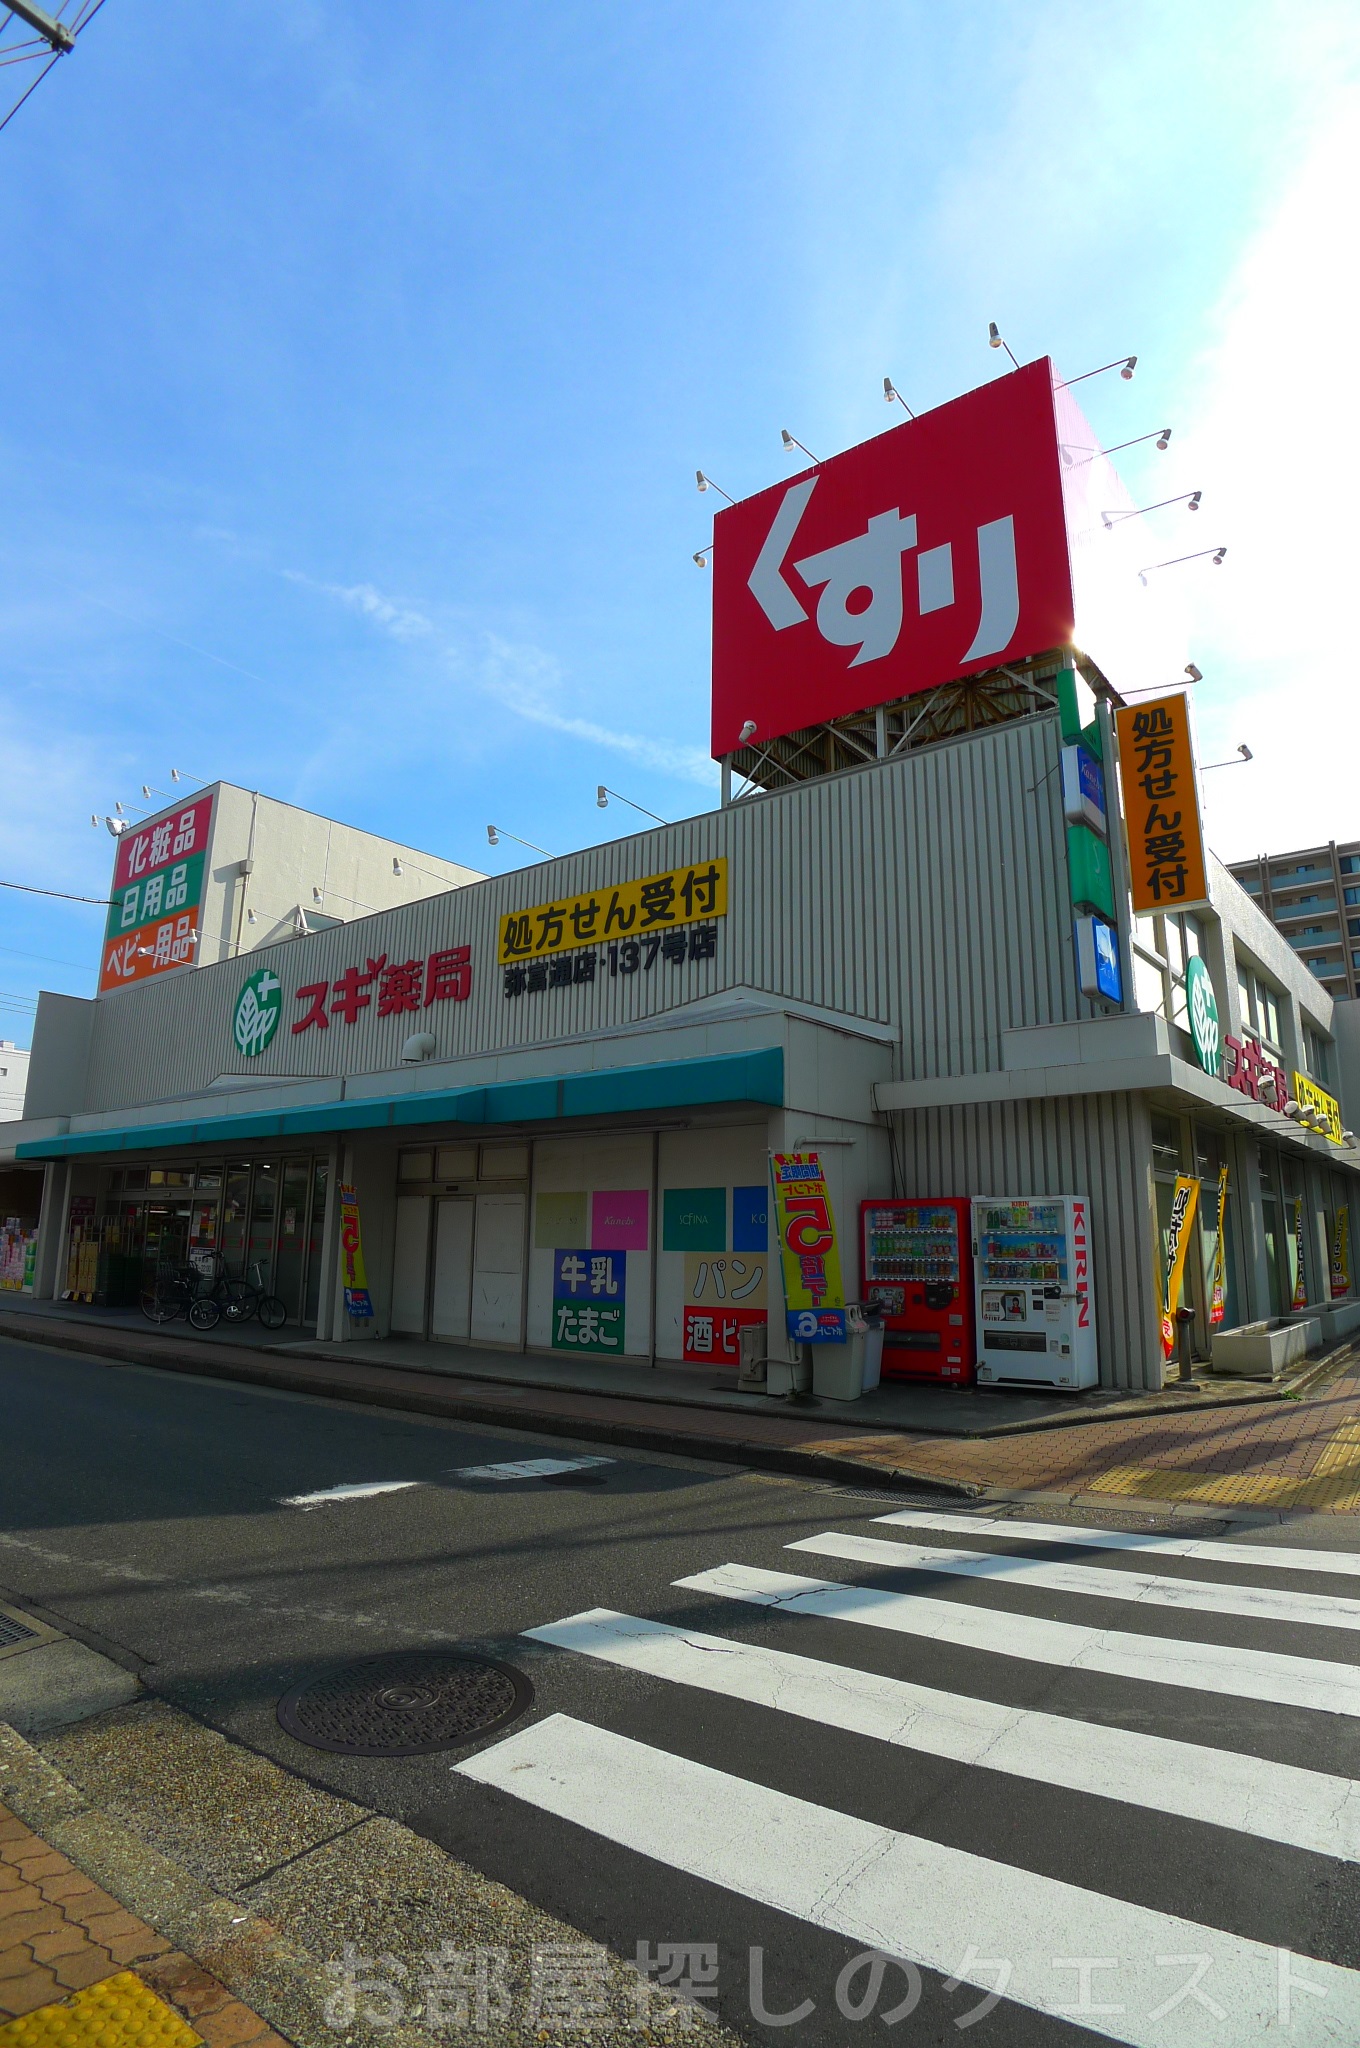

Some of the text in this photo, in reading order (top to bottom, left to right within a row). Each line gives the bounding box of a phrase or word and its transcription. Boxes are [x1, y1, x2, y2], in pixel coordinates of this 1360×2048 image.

[747, 474, 1020, 669] くすり
[1132, 708, 1188, 901] 処方せん受付
[128, 809, 196, 878] 化粧品
[120, 863, 188, 928] 日用品
[503, 865, 720, 959] 処方せん受付
[106, 915, 190, 977] ベビー用品
[291, 945, 472, 1035] スギ薬局
[560, 1255, 618, 1295] 牛乳
[693, 1259, 763, 1300] パン
[1072, 1202, 1090, 1329] KIRIN
[557, 1305, 620, 1346] たまご
[686, 1315, 741, 1354] 酒・ビ
